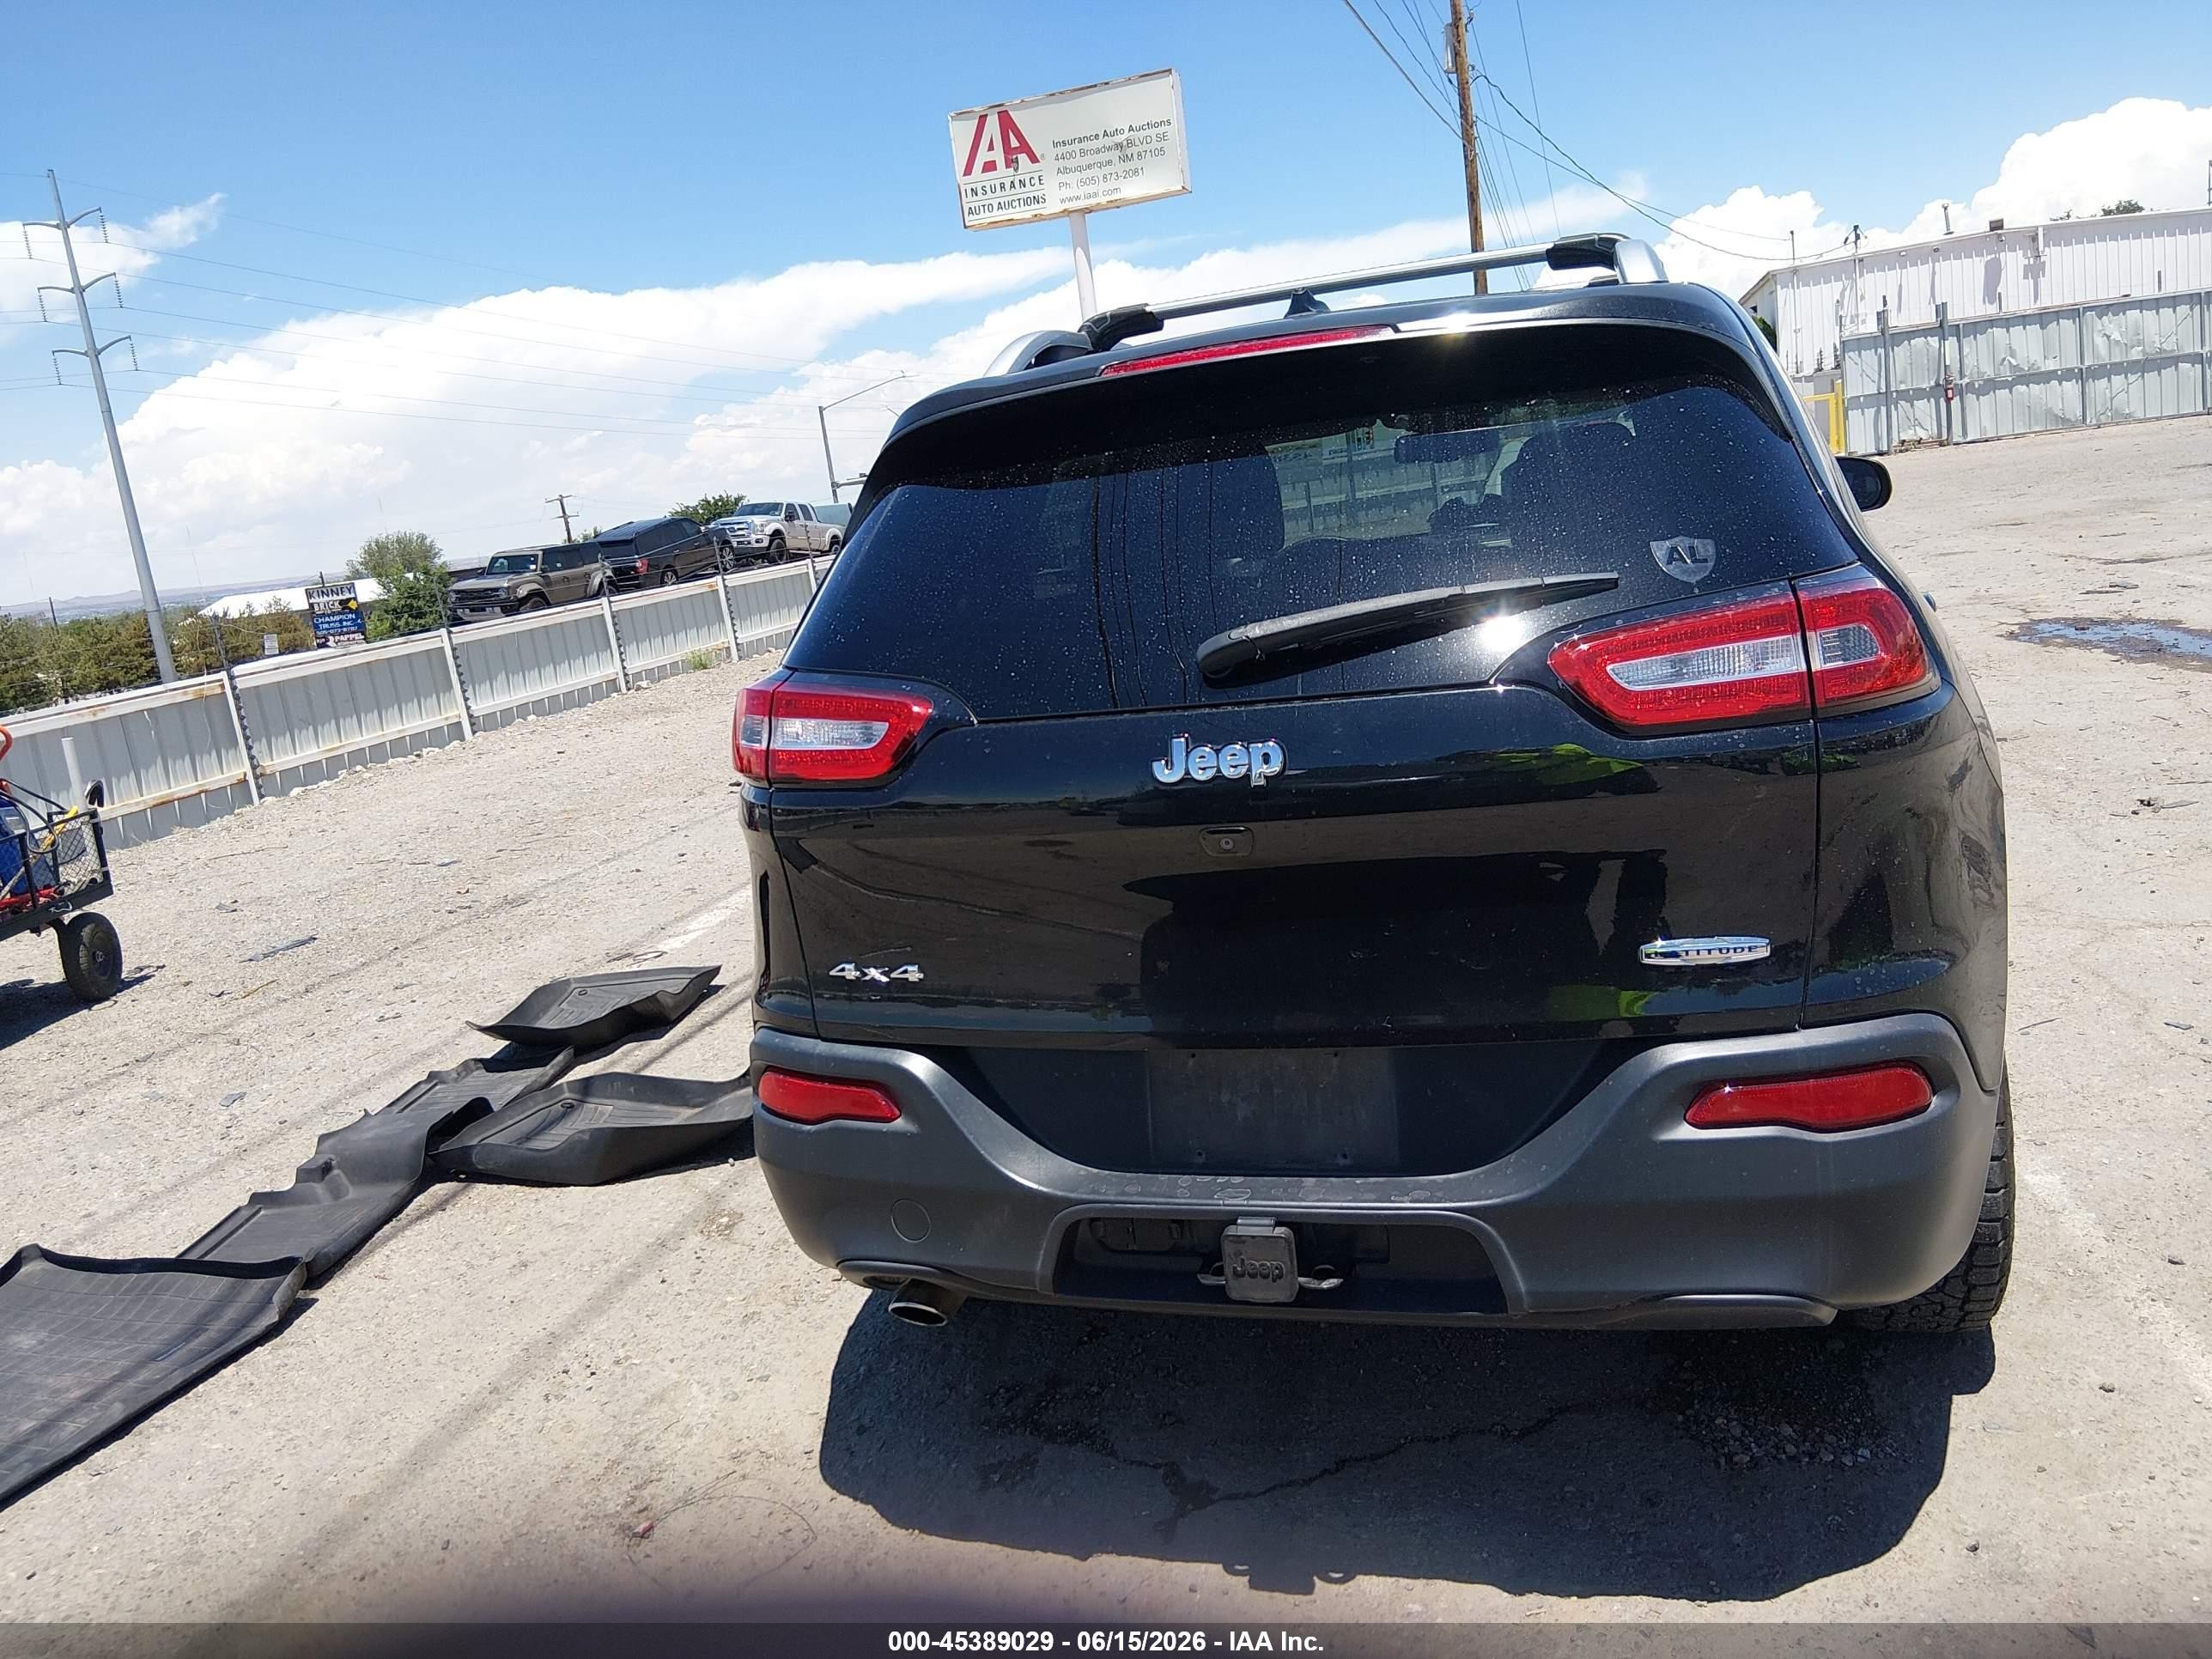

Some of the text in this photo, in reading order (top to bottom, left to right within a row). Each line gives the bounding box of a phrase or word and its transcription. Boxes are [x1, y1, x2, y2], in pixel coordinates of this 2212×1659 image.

[1052, 118, 1172, 149] Insurance Auto Auctions
[1054, 131, 1170, 162] 4400 Broadway BLVD SE
[1056, 146, 1166, 177] Albuquerque, NM 87105
[964, 174, 1045, 199] INSURANCE
[1076, 175, 1100, 191] (505)
[1102, 167, 1145, 184] 873-2081
[967, 193, 1047, 217] AUTO AUCTIONS
[1058, 186, 1122, 205] www.iaai.com
[1665, 543, 1709, 566] AL
[308, 586, 353, 600] KINNEY
[313, 600, 343, 611] BRICK
[313, 613, 356, 623] CHAMPION
[1152, 733, 1285, 787] Jeep
[829, 962, 925, 982] 4x4
[1232, 1255, 1285, 1283] Jeep
